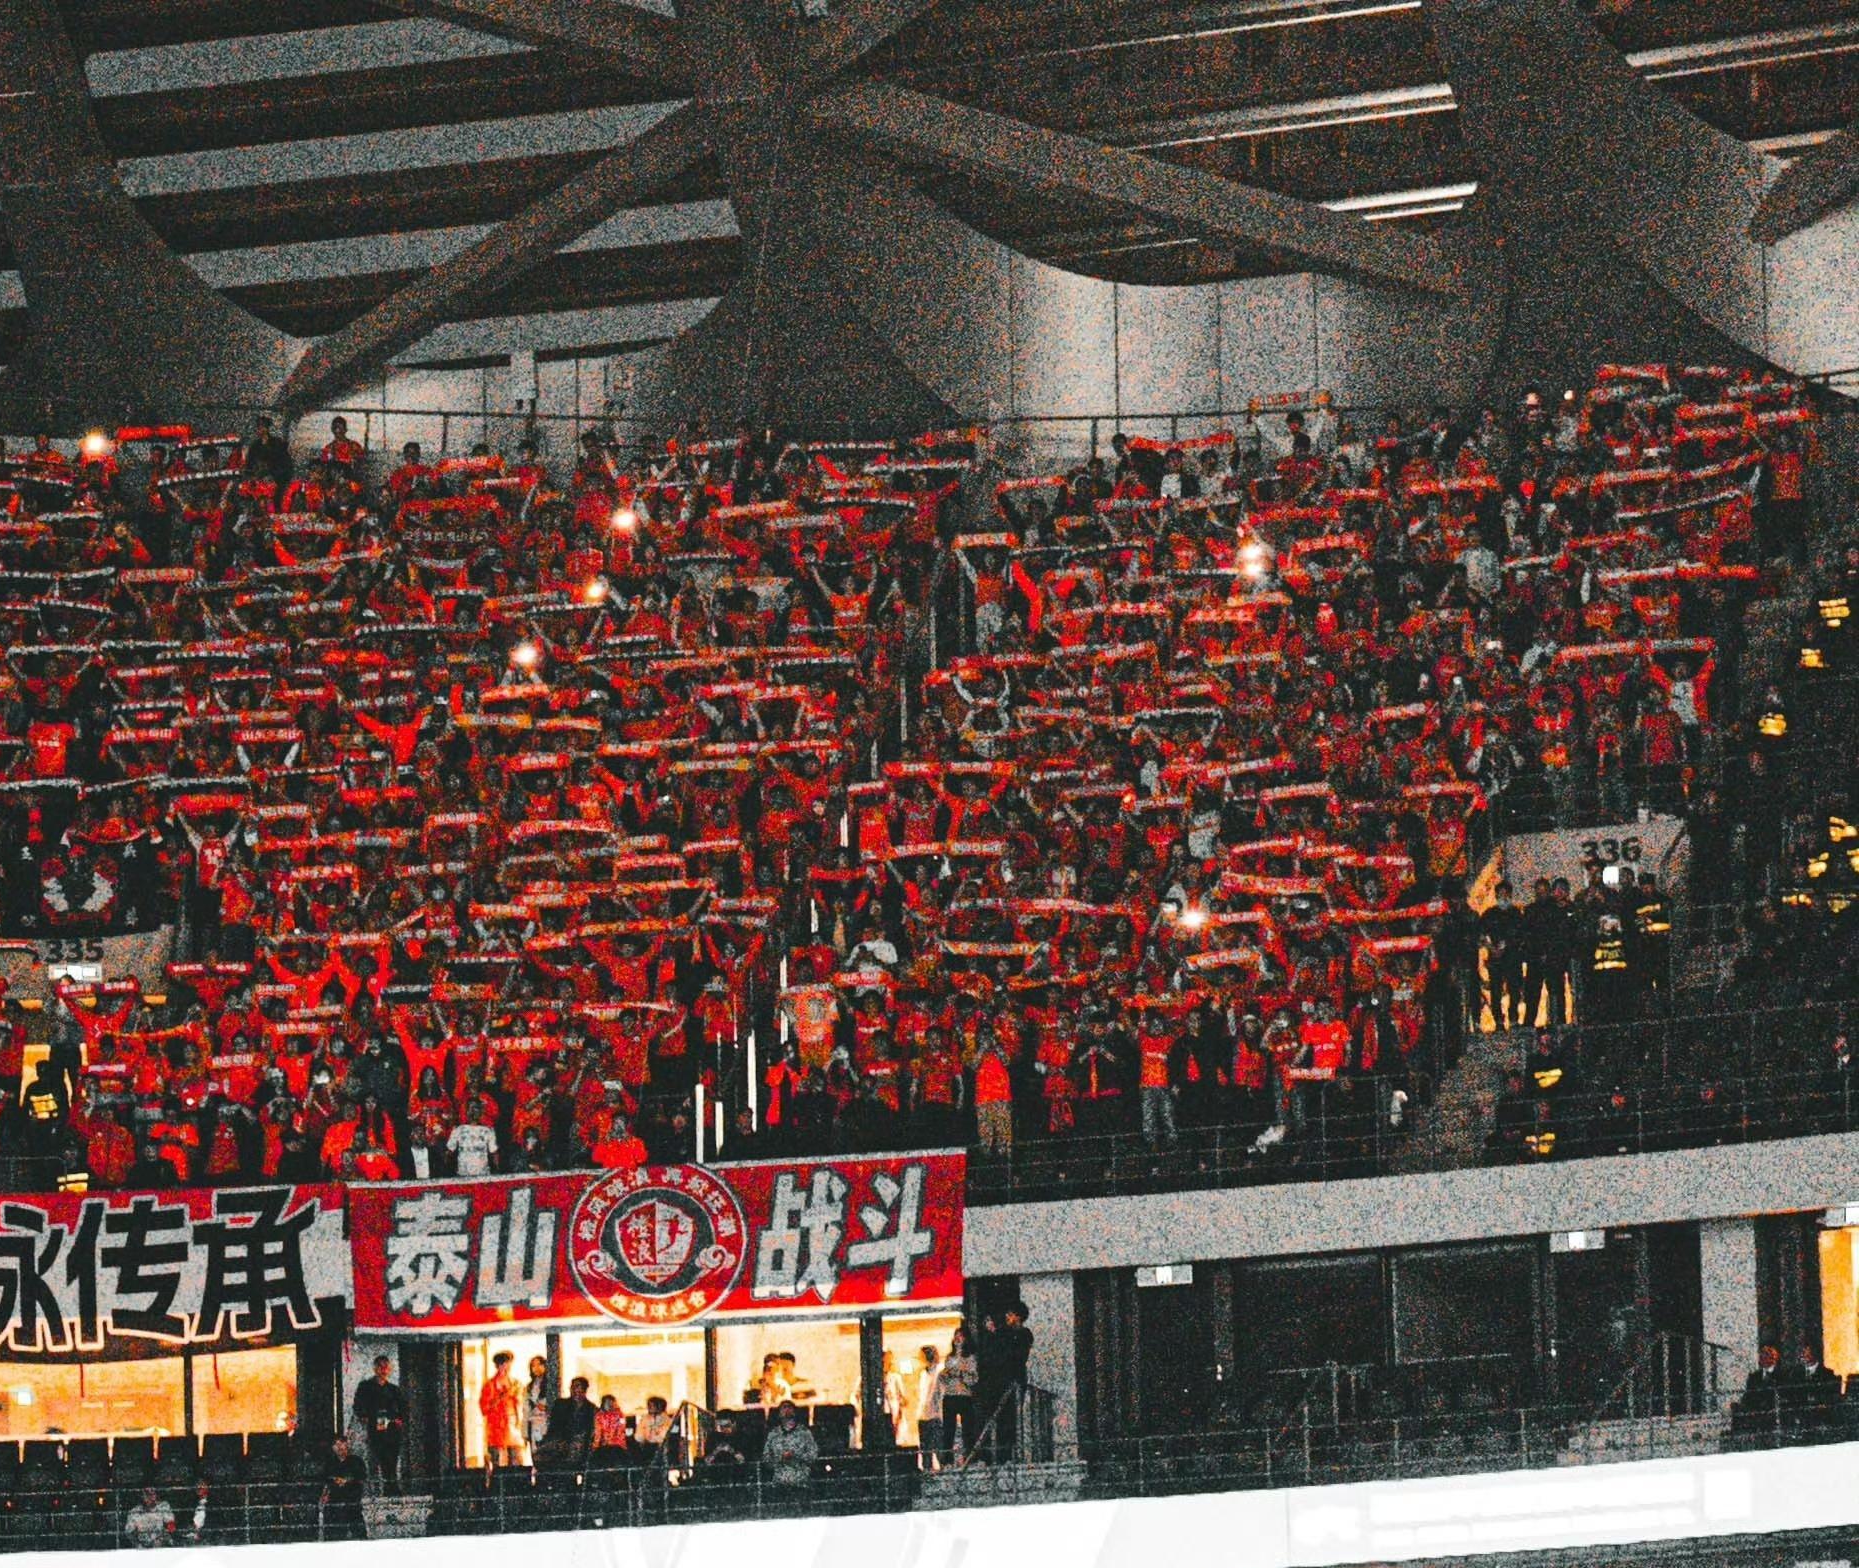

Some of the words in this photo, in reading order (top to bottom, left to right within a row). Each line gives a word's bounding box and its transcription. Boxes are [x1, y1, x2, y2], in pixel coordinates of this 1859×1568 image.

[1581, 838, 1641, 862] 336
[37, 938, 104, 963] 335
[386, 1186, 556, 1314] 泰山
[750, 1165, 935, 1302] 战斗
